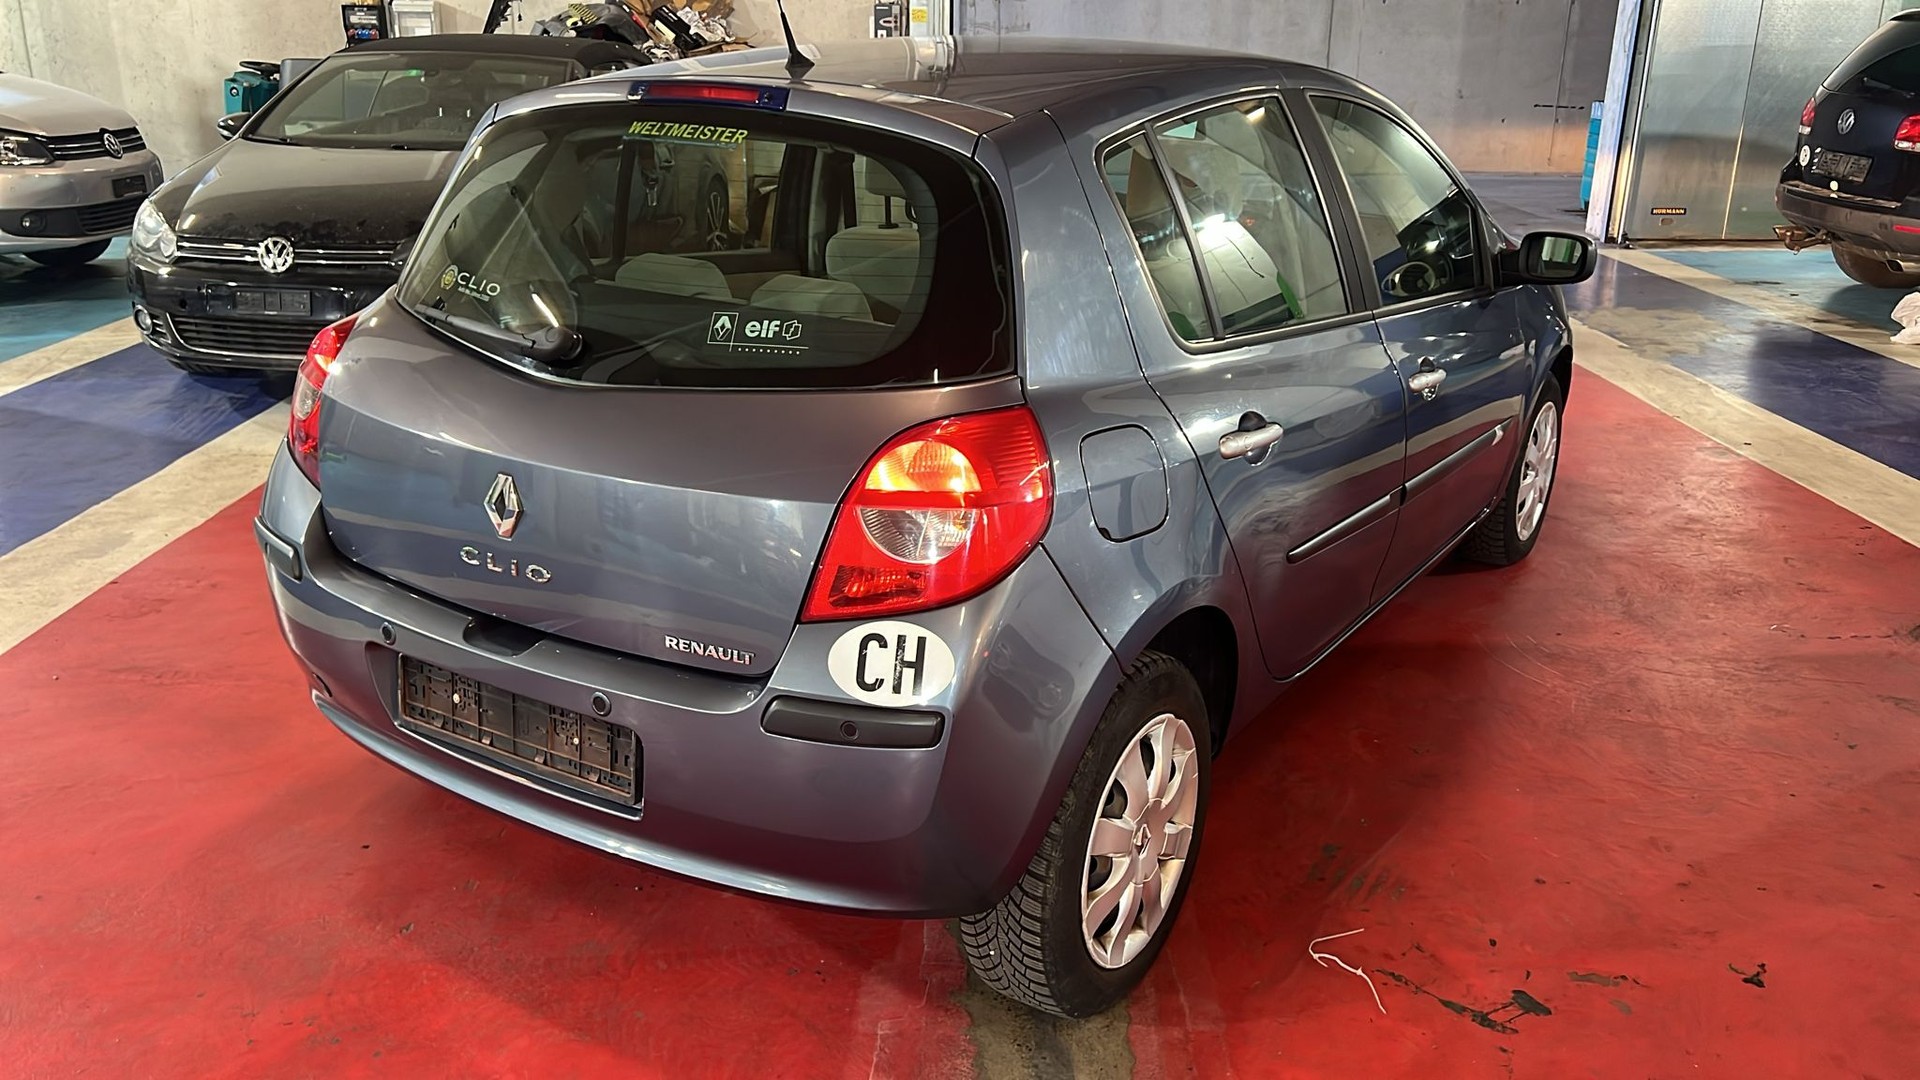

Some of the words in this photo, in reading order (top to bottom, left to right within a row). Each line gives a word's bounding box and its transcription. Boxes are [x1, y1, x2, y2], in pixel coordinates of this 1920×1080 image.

[628, 120, 748, 144] WELTMEISTER
[457, 272, 501, 296] CLIO
[744, 319, 781, 338] elf
[460, 546, 552, 583] CLIO
[664, 634, 755, 665] RENAULT
[855, 632, 927, 696] CH
